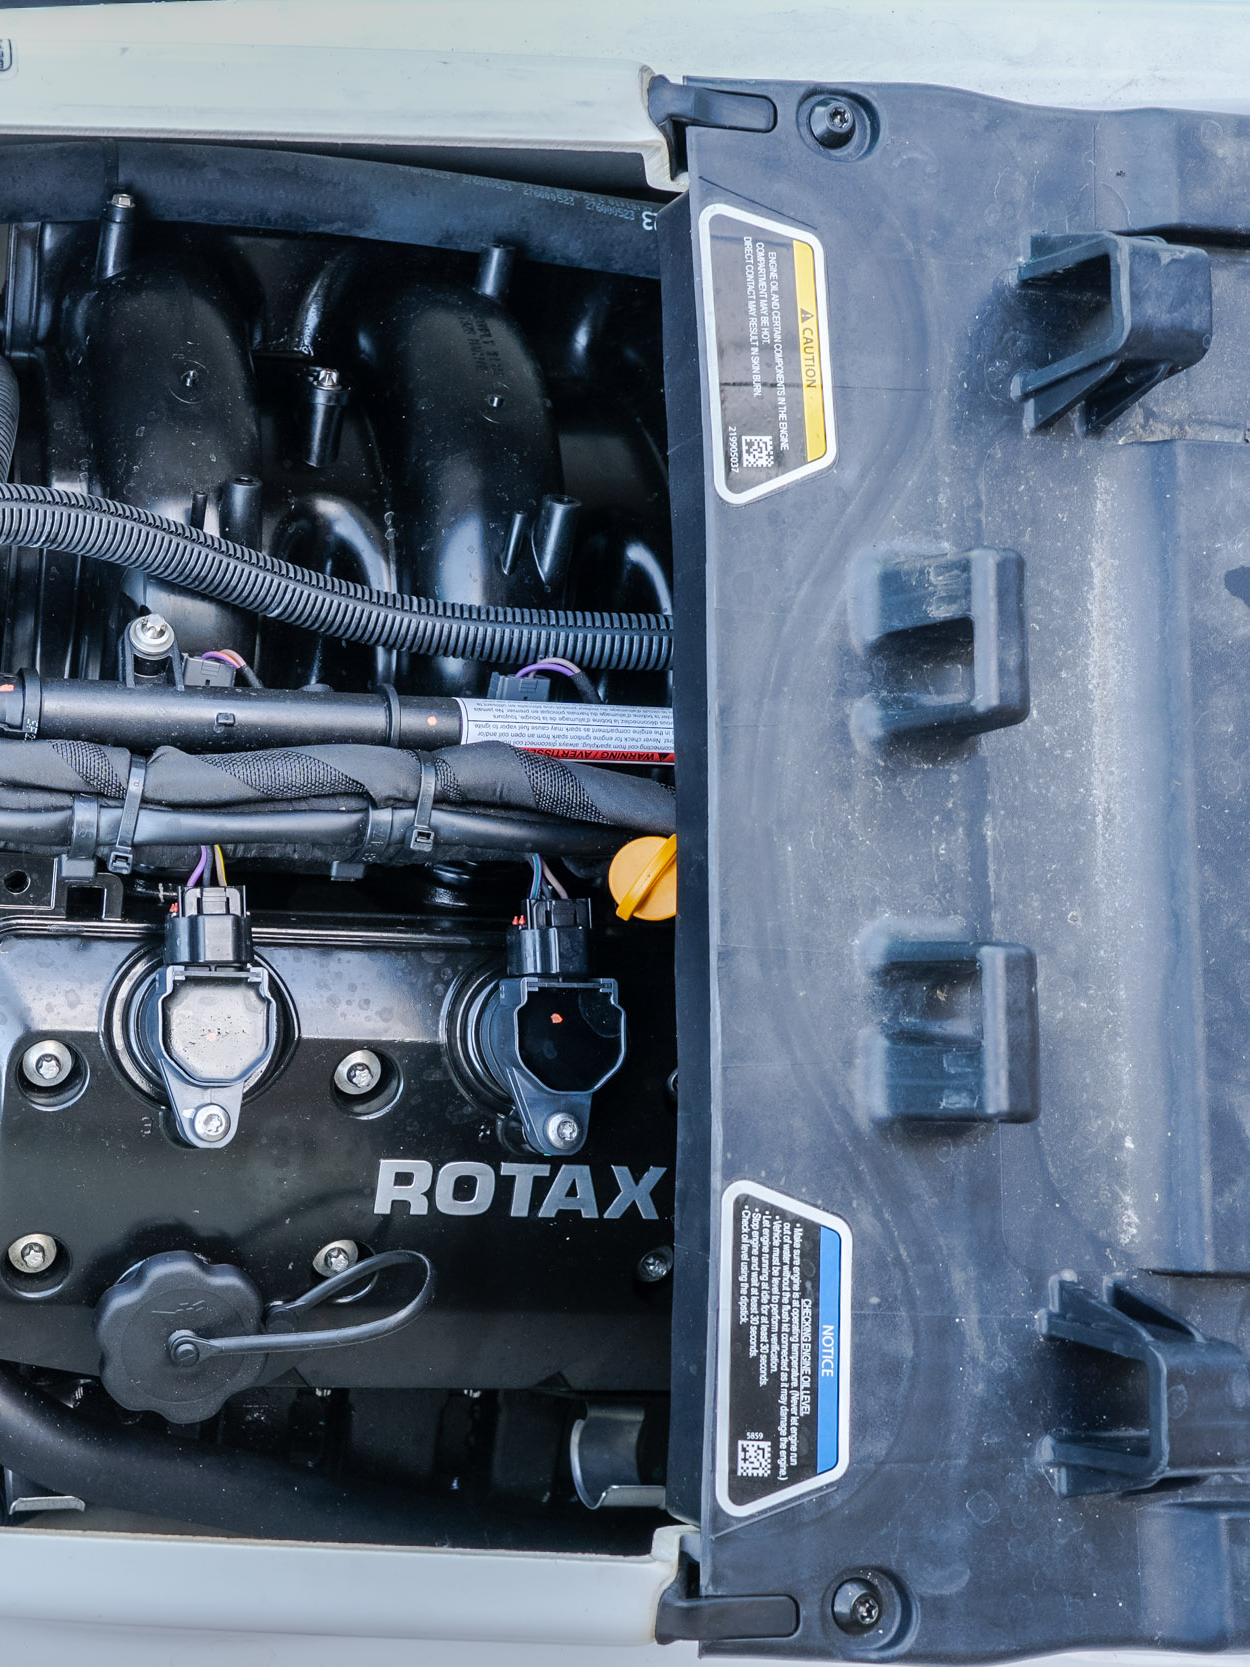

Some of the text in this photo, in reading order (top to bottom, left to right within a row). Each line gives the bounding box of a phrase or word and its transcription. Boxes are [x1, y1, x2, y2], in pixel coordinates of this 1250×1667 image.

[755, 242, 770, 344] COMPARTMENT MAY BE HOT.
[743, 236, 762, 397] DIRECT CONTACT MAY RESULT IN SKIN BURN.
[768, 251, 789, 450] ENGINE OIL AND CERTAIN COMPONENTS IN THE ENGINE
[802, 327, 817, 388] CAUTION
[728, 425, 740, 473] 219905037
[558, 740, 579, 748] always
[582, 741, 611, 749] sparkplug,
[599, 751, 656, 761] WARNING
[374, 1159, 668, 1220] ROTAX
[782, 1222, 792, 1235] out
[782, 1234, 792, 1244] of
[738, 1209, 751, 1325] Check oil level using the dipstick.
[782, 1243, 791, 1265] water
[749, 1212, 761, 1358] Stop engine and wait at least 30 seconds.
[781, 1264, 792, 1291] without
[758, 1215, 771, 1387] Let engine running at idle for at least 30 seconds.
[769, 1219, 782, 1374] Vehicle must be level to perform verification.
[781, 1291, 791, 1304] the
[781, 1304, 791, 1322] flush
[781, 1322, 790, 1332] kit
[780, 1332, 790, 1371] connected
[788, 1227, 802, 1466] Make sure engine is at operating temperature. (Never let engine run
[801, 1298, 812, 1416] CHECKING ENGINE OIL LEVEL
[821, 1324, 834, 1377] NOTICE
[780, 1371, 788, 1382] as
[778, 1388, 788, 1405] may
[778, 1405, 789, 1436] damage
[779, 1436, 789, 1449] the
[777, 1449, 788, 1481] engine.)
